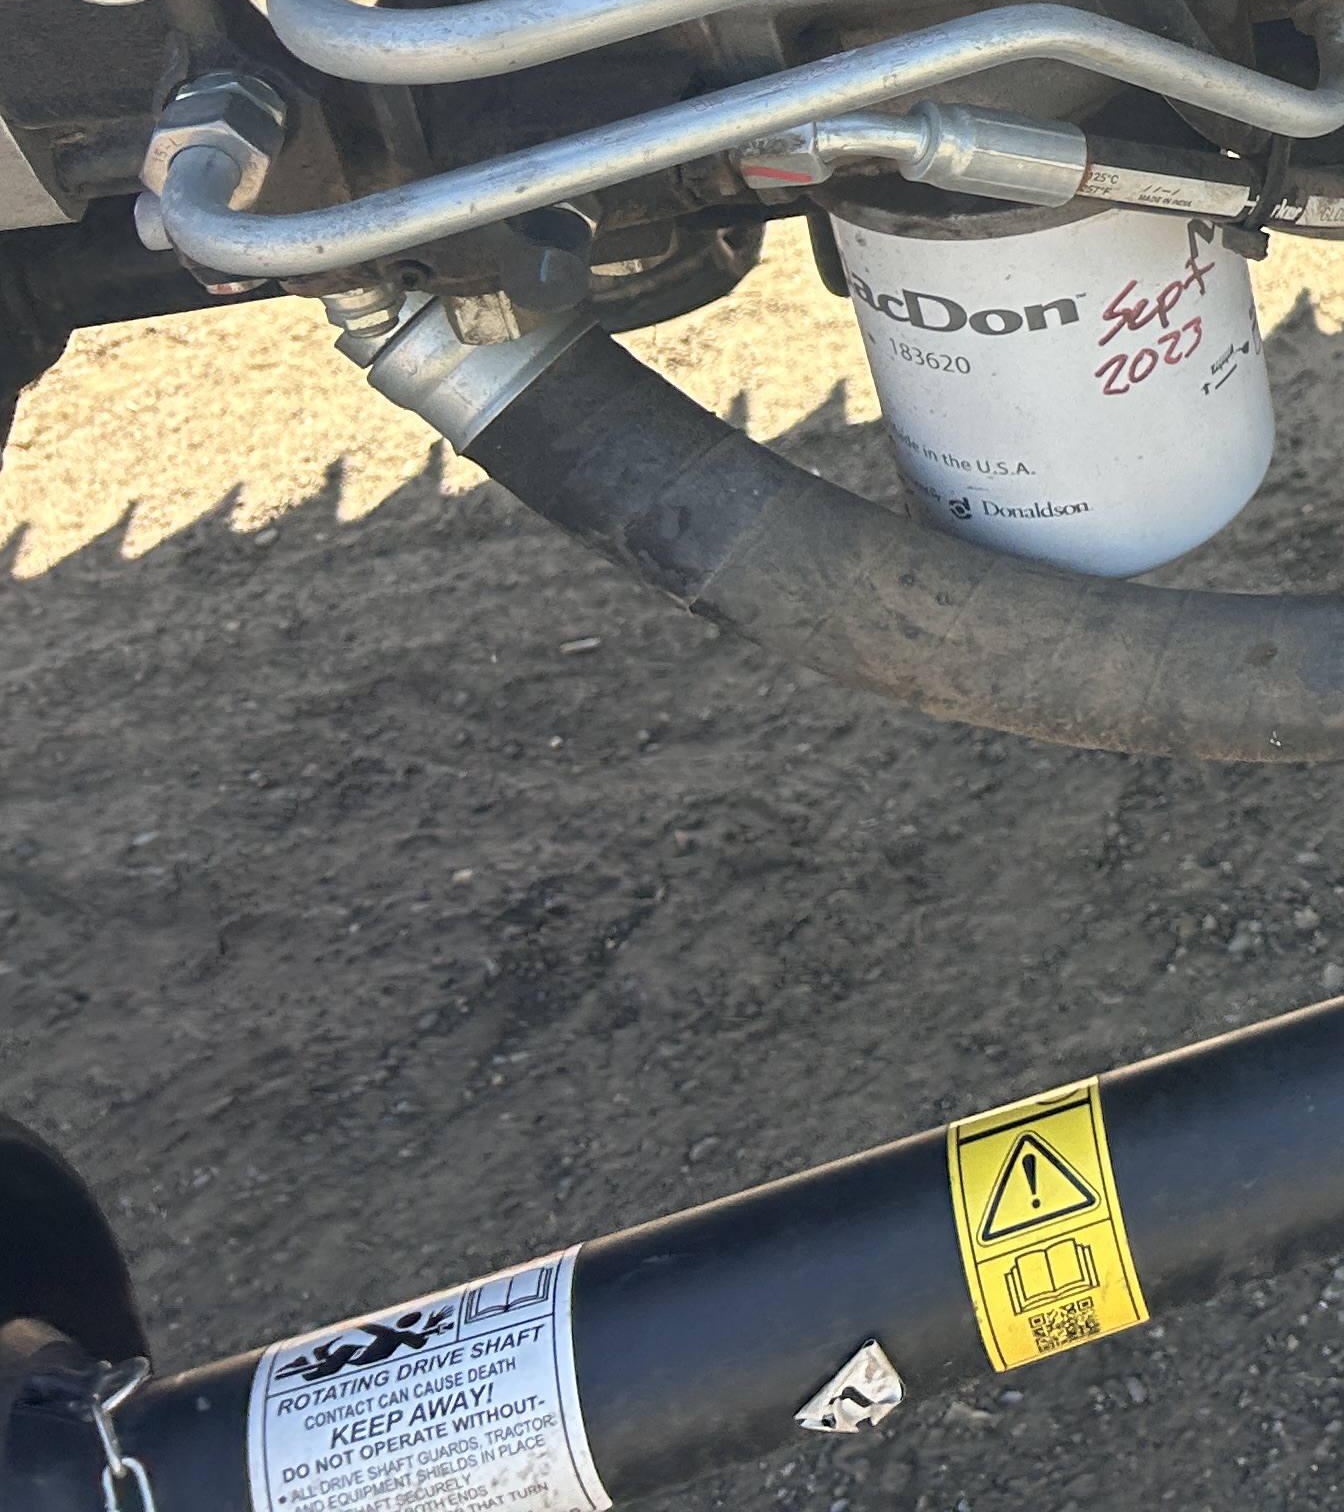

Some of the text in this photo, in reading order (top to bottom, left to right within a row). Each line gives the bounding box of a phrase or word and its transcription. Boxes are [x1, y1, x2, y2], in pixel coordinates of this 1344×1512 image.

[851, 271, 1080, 336] acDon
[889, 338, 971, 375] 183620
[1094, 316, 1202, 396] 2023
[922, 446, 1036, 477] in the U.S.A.
[981, 500, 1090, 520] Donaldson
[277, 1323, 546, 1417] ROTATING DRIVE SHAFT
[304, 1356, 517, 1430] CONTACT CAN CAUSE DEATH
[329, 1382, 495, 1450] KEEP AWAY!
[282, 1462, 311, 1484] DO
[315, 1449, 355, 1474] NOT
[359, 1421, 447, 1461] OPERATE
[291, 1485, 317, 1503] ALL
[319, 1469, 365, 1495] DRIVE
[367, 1453, 415, 1481] SHAFT
[417, 1438, 484, 1467] GUARDS,
[327, 1472, 413, 1509] EQUIPMENT
[416, 1456, 479, 1483] SHIELDS
[481, 1448, 497, 1465] IN
[499, 1434, 546, 1459] PLACE
[391, 1473, 473, 1506] SECURELY
[447, 1484, 489, 1503] ENDS
